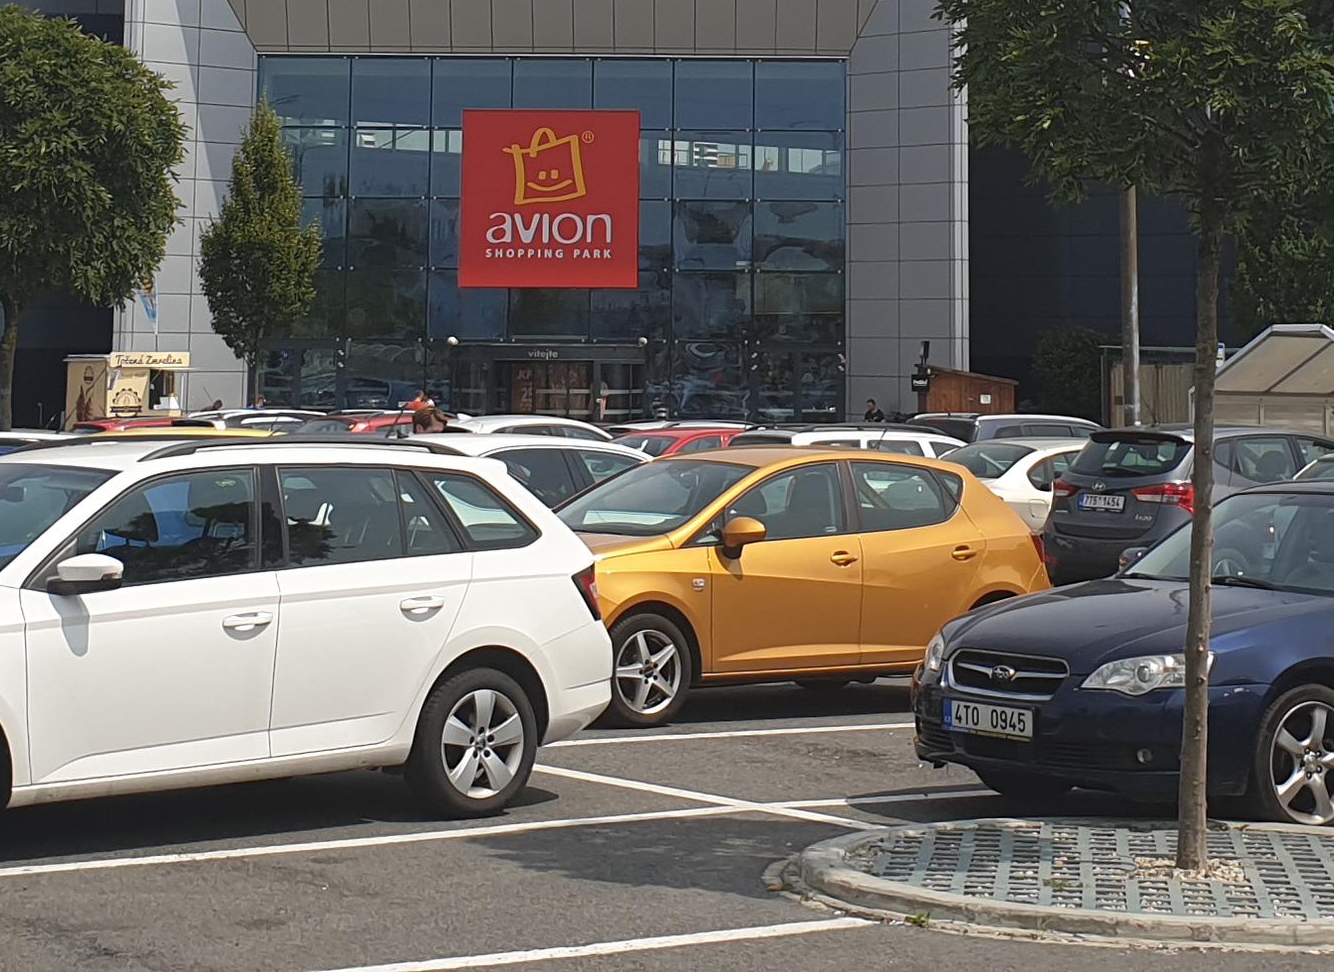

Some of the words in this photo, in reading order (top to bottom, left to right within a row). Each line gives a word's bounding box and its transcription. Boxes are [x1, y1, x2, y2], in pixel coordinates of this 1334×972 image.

[485, 211, 612, 244] avion
[485, 248, 564, 259] SHOPPING
[573, 248, 612, 259] PARK
[990, 708, 1026, 733] 0945
